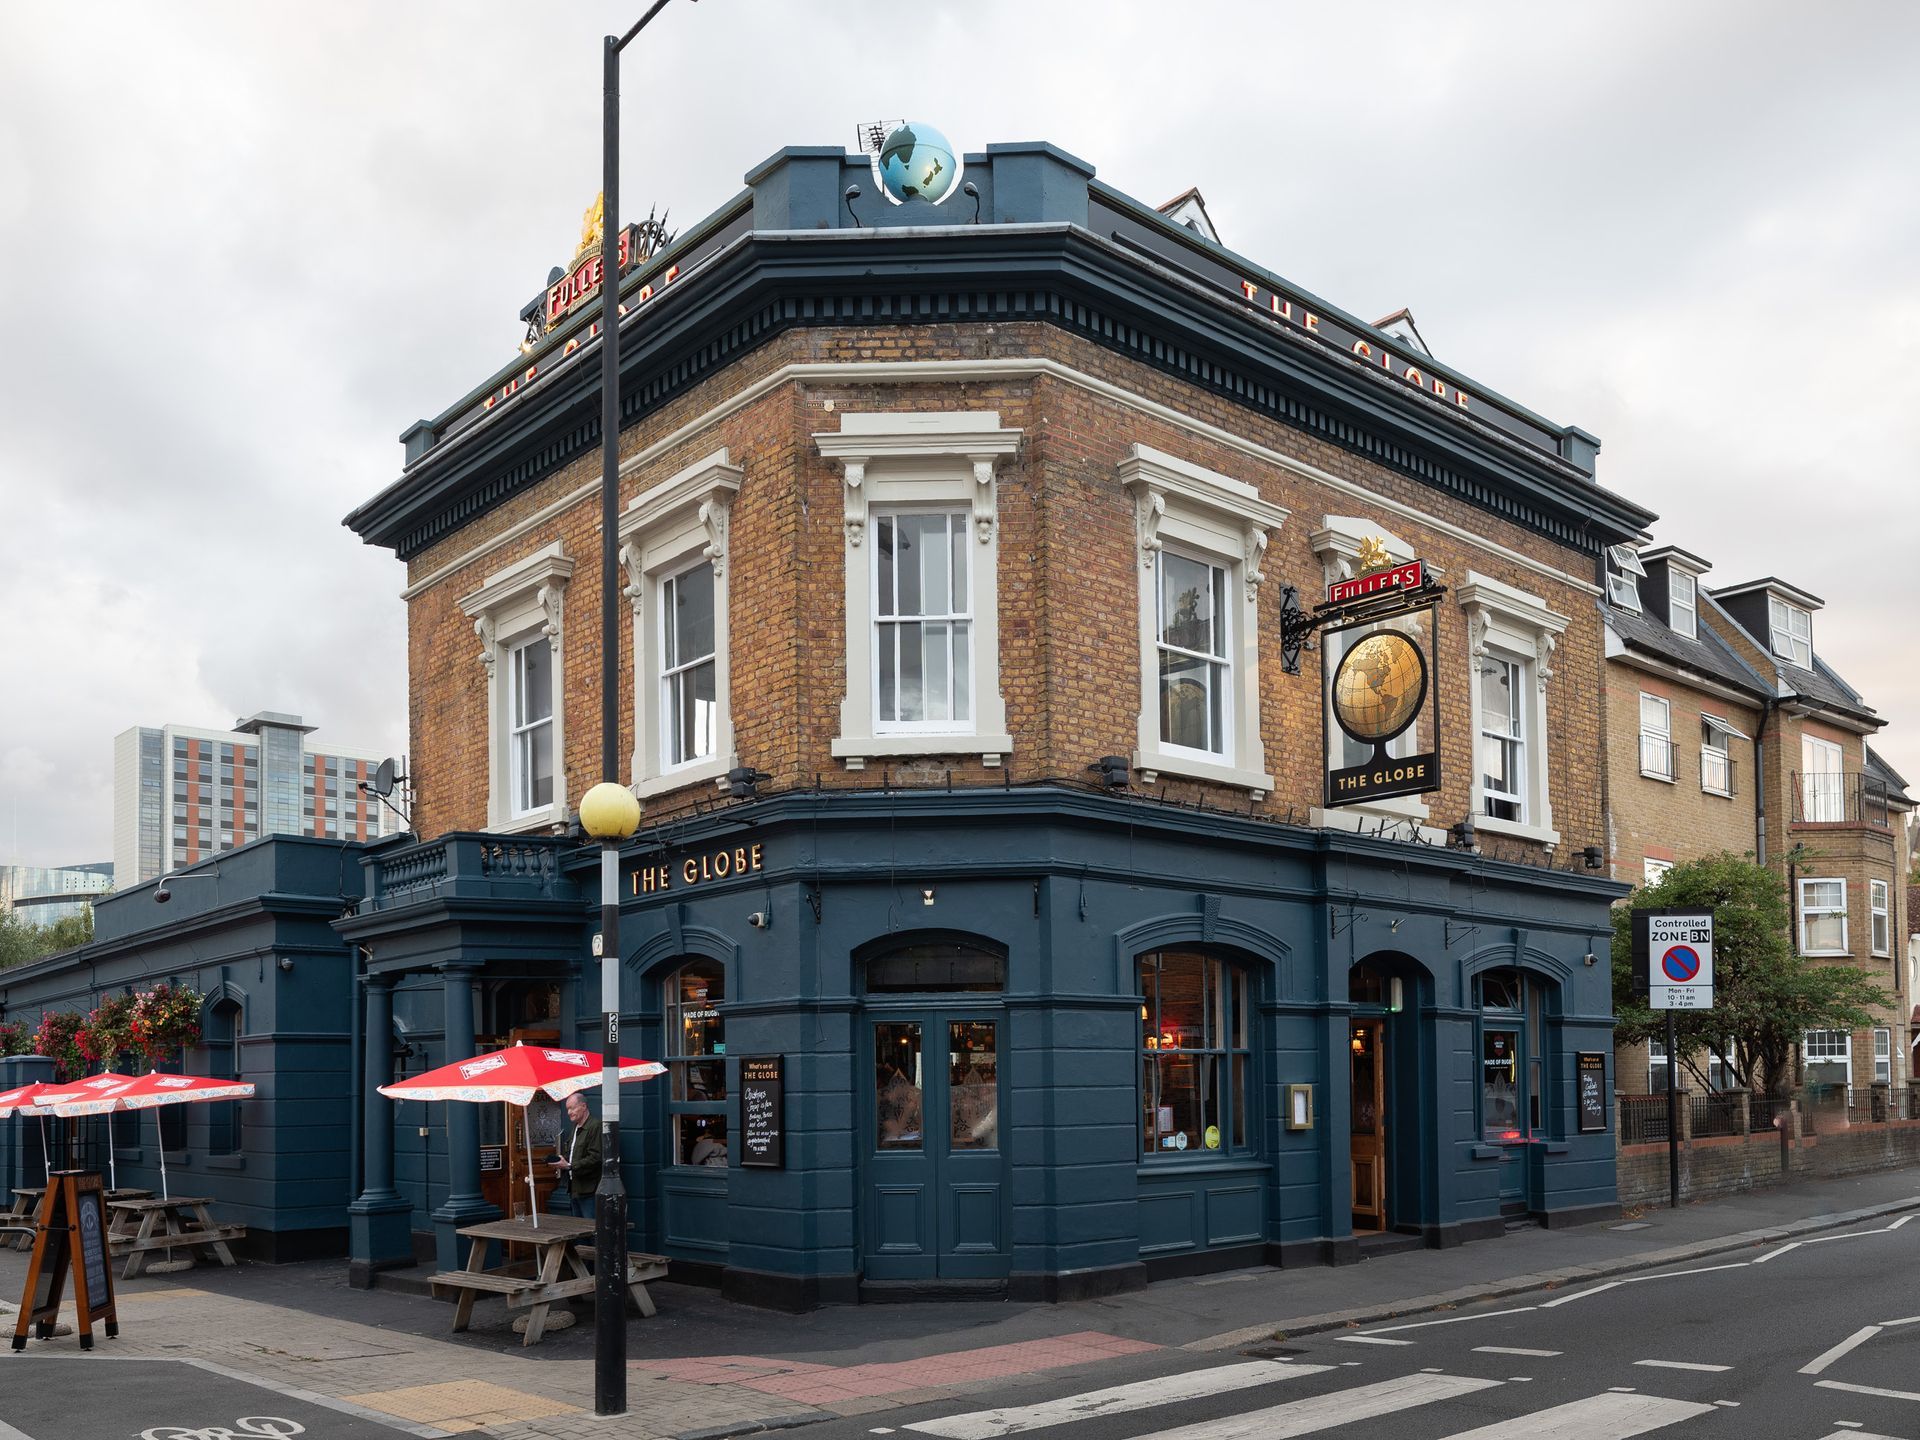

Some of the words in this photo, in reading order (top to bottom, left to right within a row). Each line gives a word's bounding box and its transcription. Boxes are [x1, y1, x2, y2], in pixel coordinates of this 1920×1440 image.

[548, 240, 628, 317] FULLES
[1338, 774, 1367, 790] THE
[1373, 764, 1425, 785] GLOBE
[631, 865, 670, 895] THE
[683, 844, 763, 885] GLOBE
[1655, 919, 1706, 927] Controlled
[1652, 932, 1688, 941] ZONE
[1691, 931, 1710, 941] BN
[683, 1011, 697, 1019] MADE
[697, 1010, 704, 1018] OF
[610, 1013, 618, 1042] 20B
[744, 1071, 756, 1079] THE
[757, 1071, 778, 1079] GLOBE
